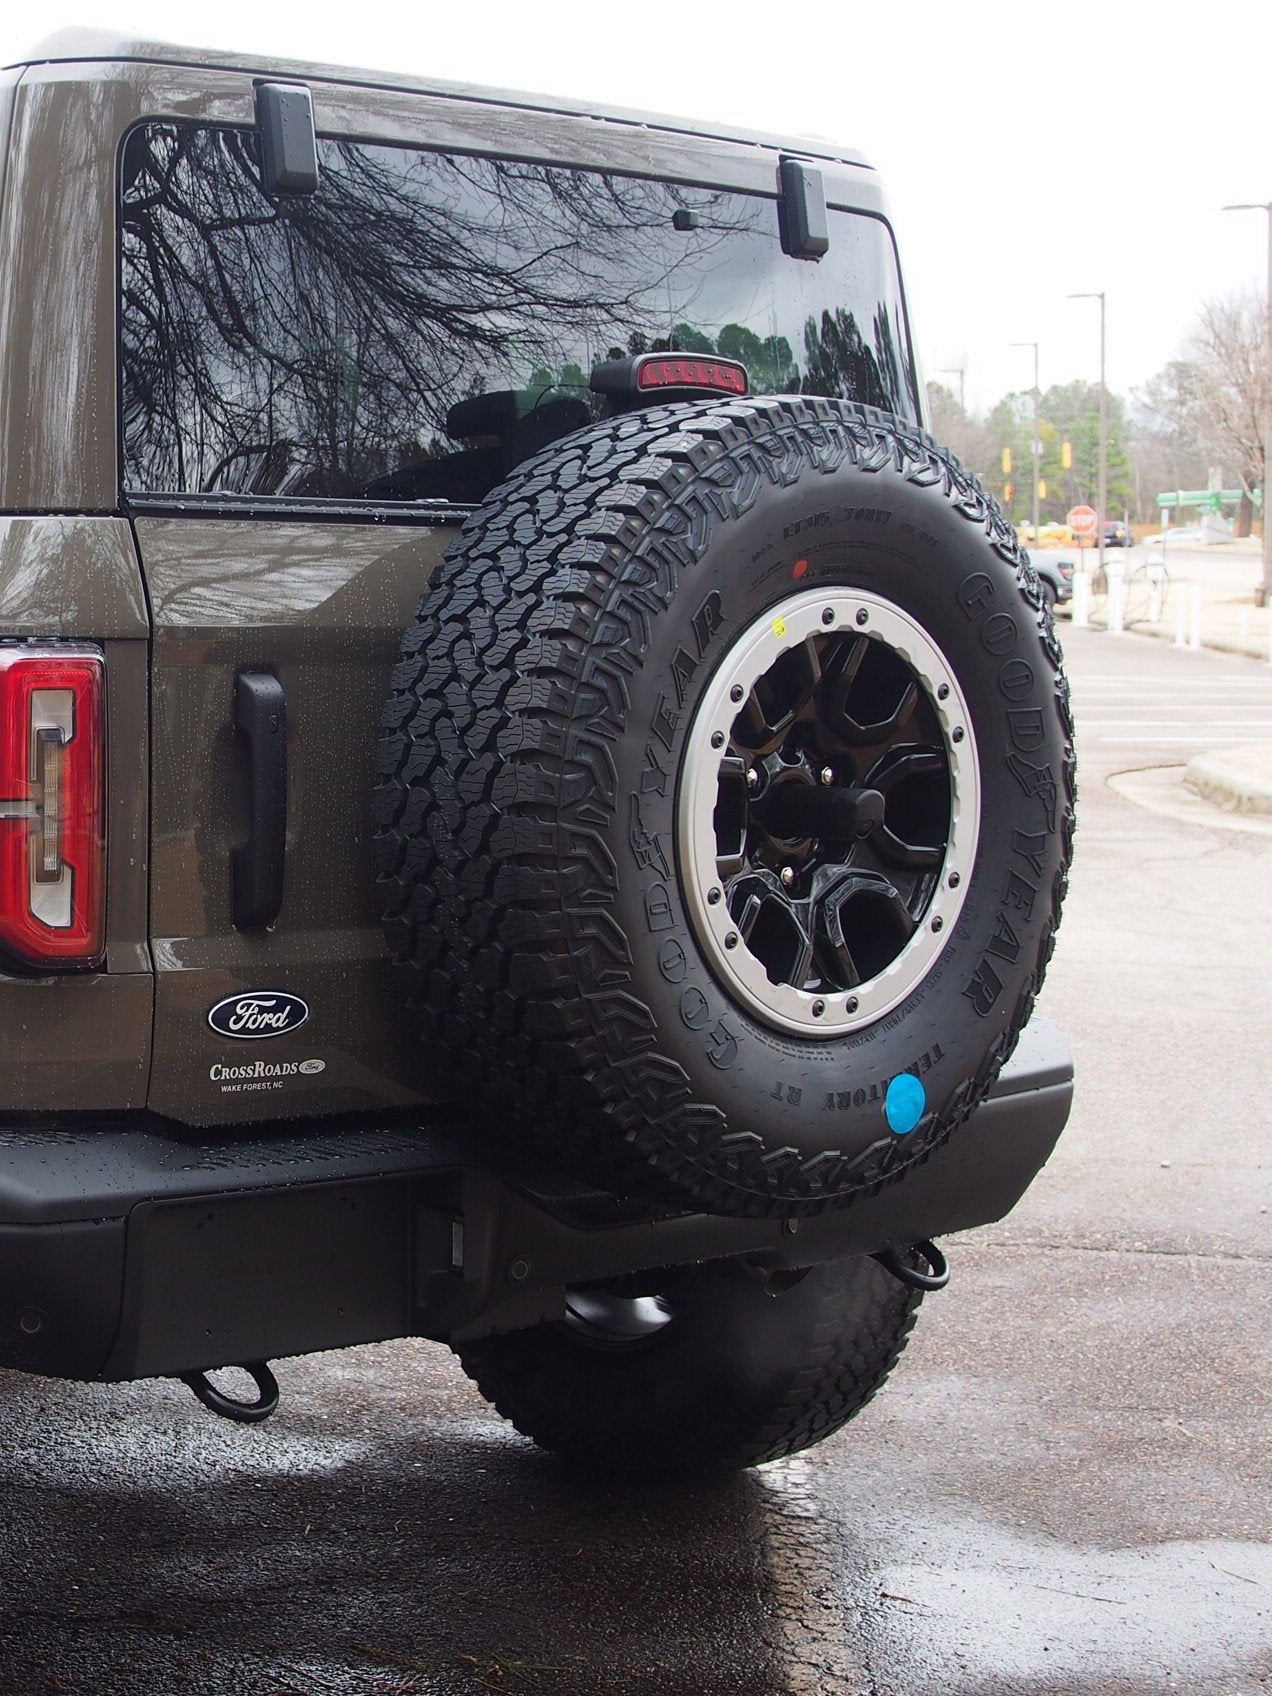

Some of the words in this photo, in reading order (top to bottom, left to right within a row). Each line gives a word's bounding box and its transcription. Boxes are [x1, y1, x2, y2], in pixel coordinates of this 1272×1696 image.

[1070, 513, 1095, 527] STOP
[958, 572, 1056, 1017] GOODYEAR
[631, 589, 737, 1070] GOODYEAR
[228, 999, 292, 1031] Ford
[221, 1084, 242, 1093] WAKE
[242, 1082, 272, 1091] FOREST,
[272, 1081, 284, 1089] NC
[823, 1043, 946, 1111] TERITORY
[771, 1081, 803, 1107] RT
